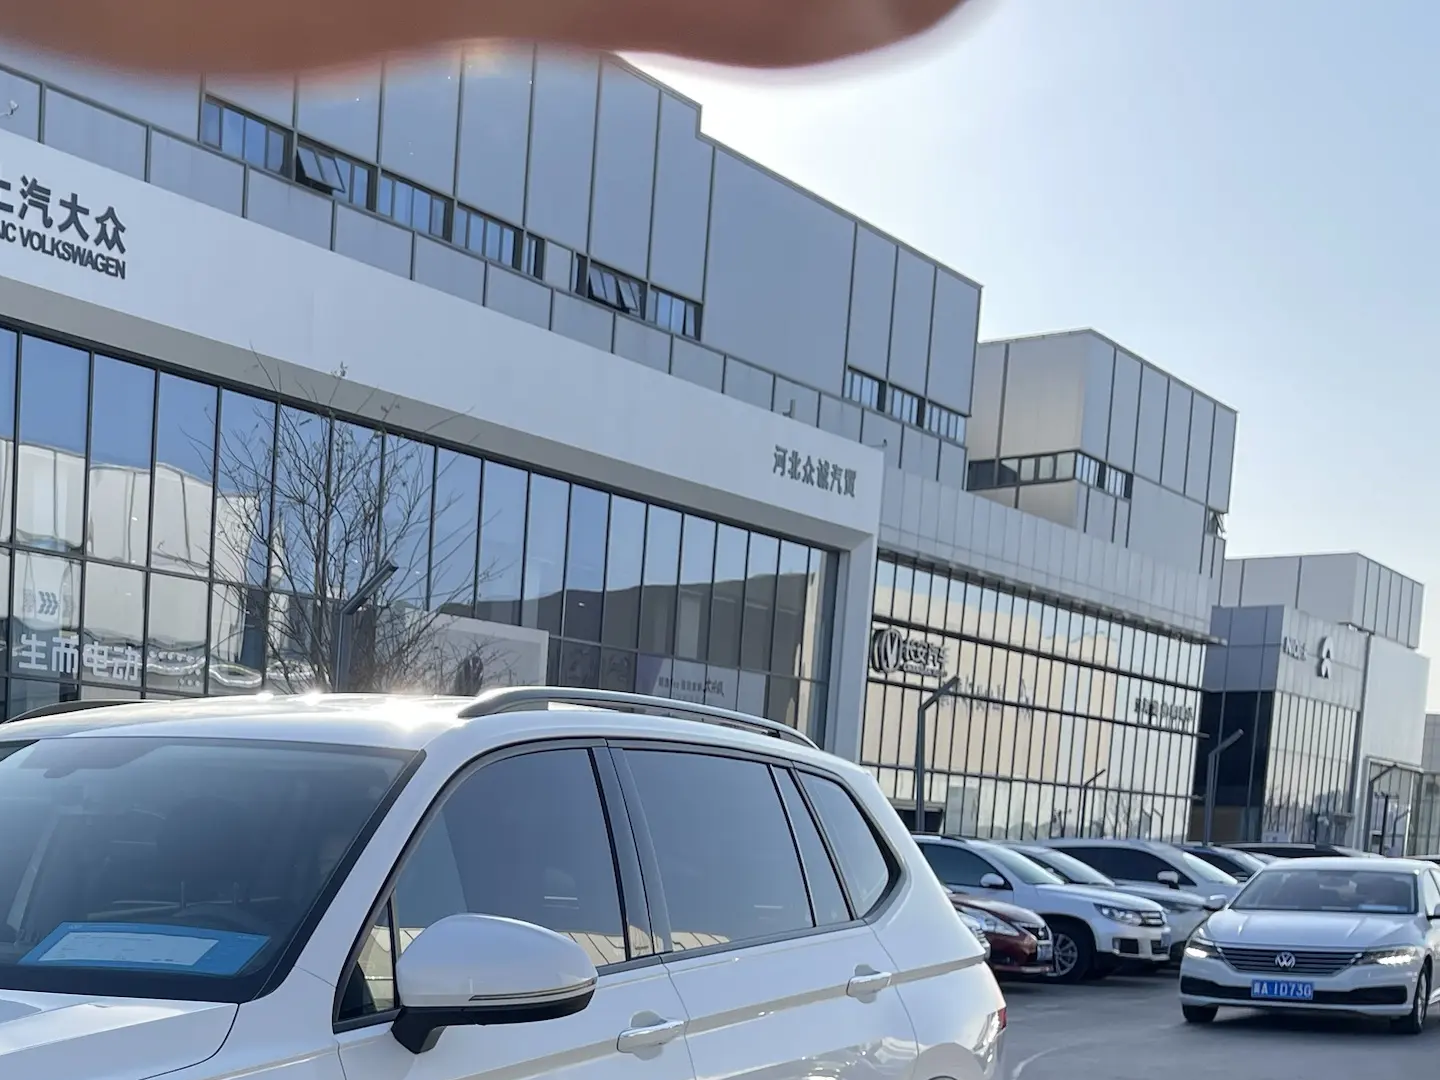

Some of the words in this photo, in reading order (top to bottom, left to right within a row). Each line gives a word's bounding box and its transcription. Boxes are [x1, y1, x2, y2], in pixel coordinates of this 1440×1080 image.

[19, 226, 126, 280] VOLKSWAGEN
[772, 444, 857, 498] 河北众诚汽贸
[18, 633, 141, 681] 生而电动
